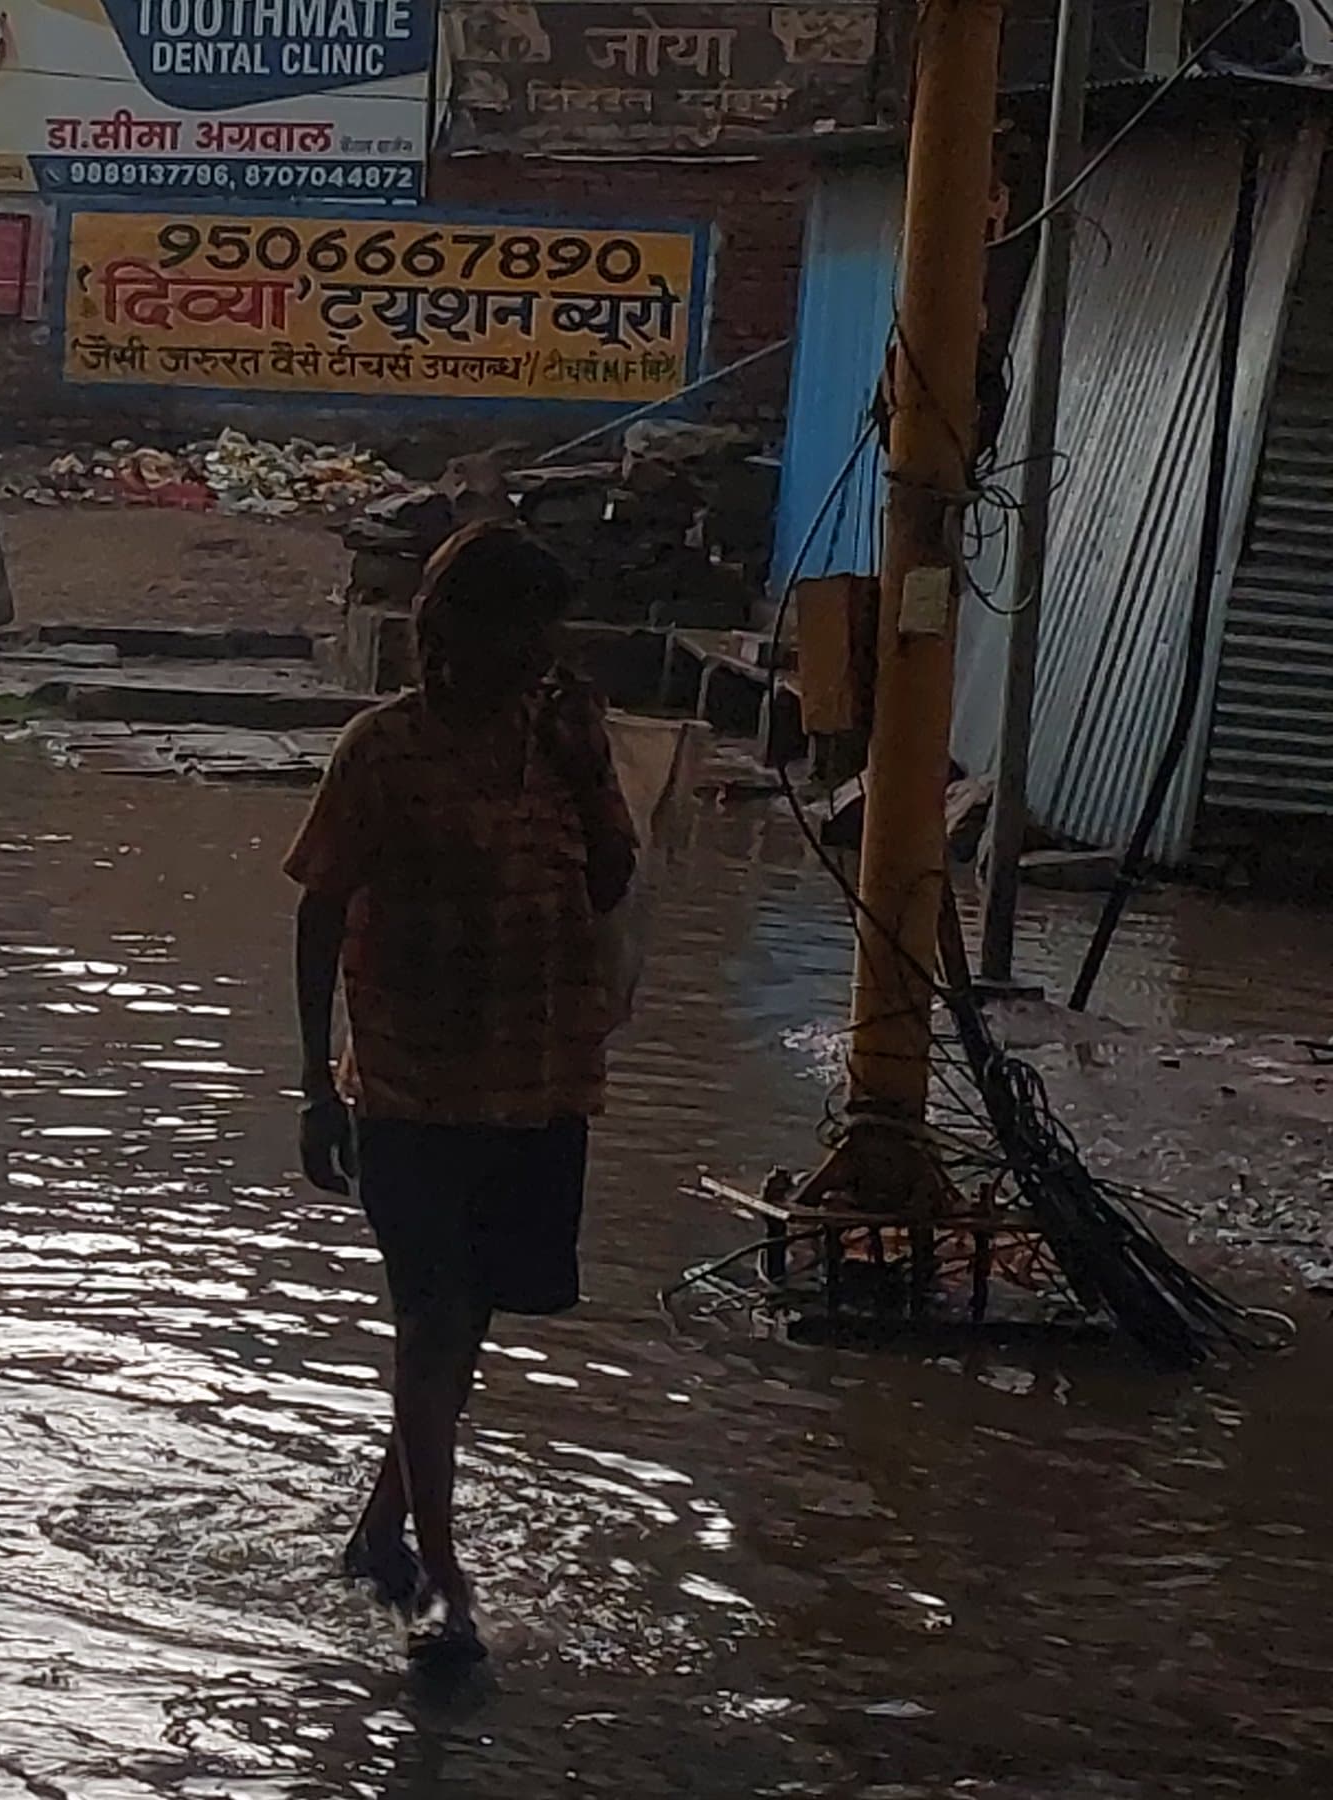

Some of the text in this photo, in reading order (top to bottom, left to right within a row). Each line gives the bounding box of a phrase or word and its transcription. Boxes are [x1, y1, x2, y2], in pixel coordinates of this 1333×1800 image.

[138, 0, 411, 39] TOOTHMATE
[152, 41, 385, 76] DENTAL CLINIC
[584, 8, 738, 77] जोया
[195, 121, 335, 154] अग्रवाल
[244, 164, 414, 188] 8707044872
[157, 223, 642, 284] 9506667890
